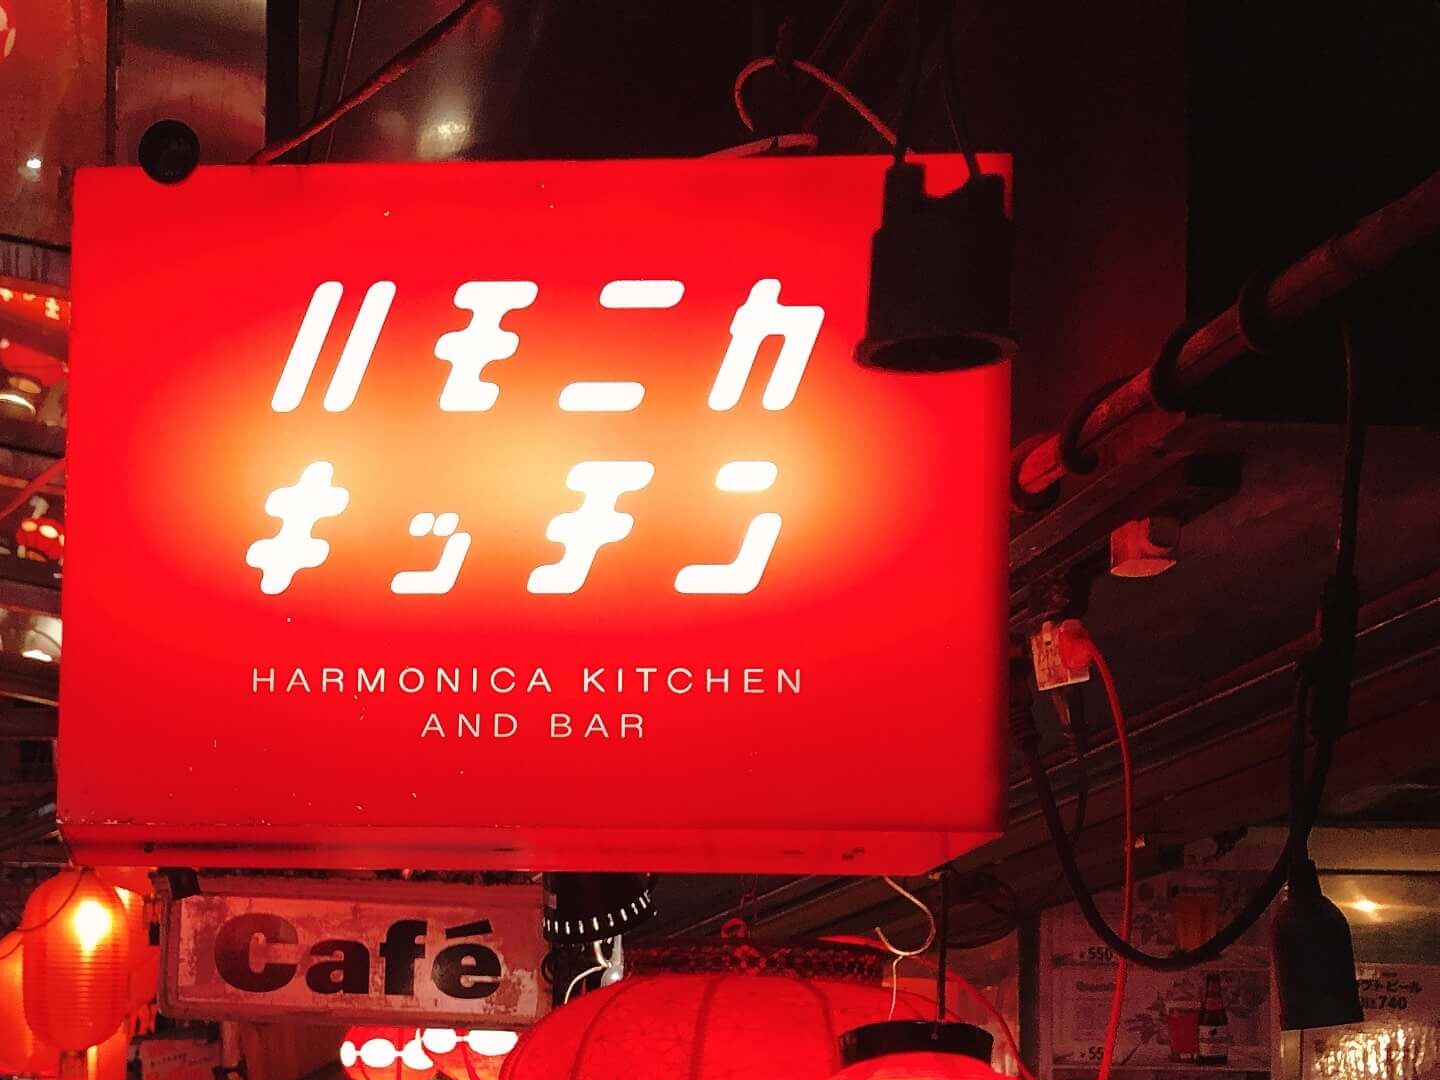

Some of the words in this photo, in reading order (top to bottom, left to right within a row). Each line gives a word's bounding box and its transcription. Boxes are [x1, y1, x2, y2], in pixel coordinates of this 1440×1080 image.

[271, 278, 825, 412] ハモニカ
[245, 460, 782, 595] キッチン
[252, 667, 552, 694] HARMONICA
[582, 667, 802, 694] KITCHEN
[421, 713, 518, 738] AND
[550, 713, 644, 738] BAR
[214, 912, 502, 999] Café
